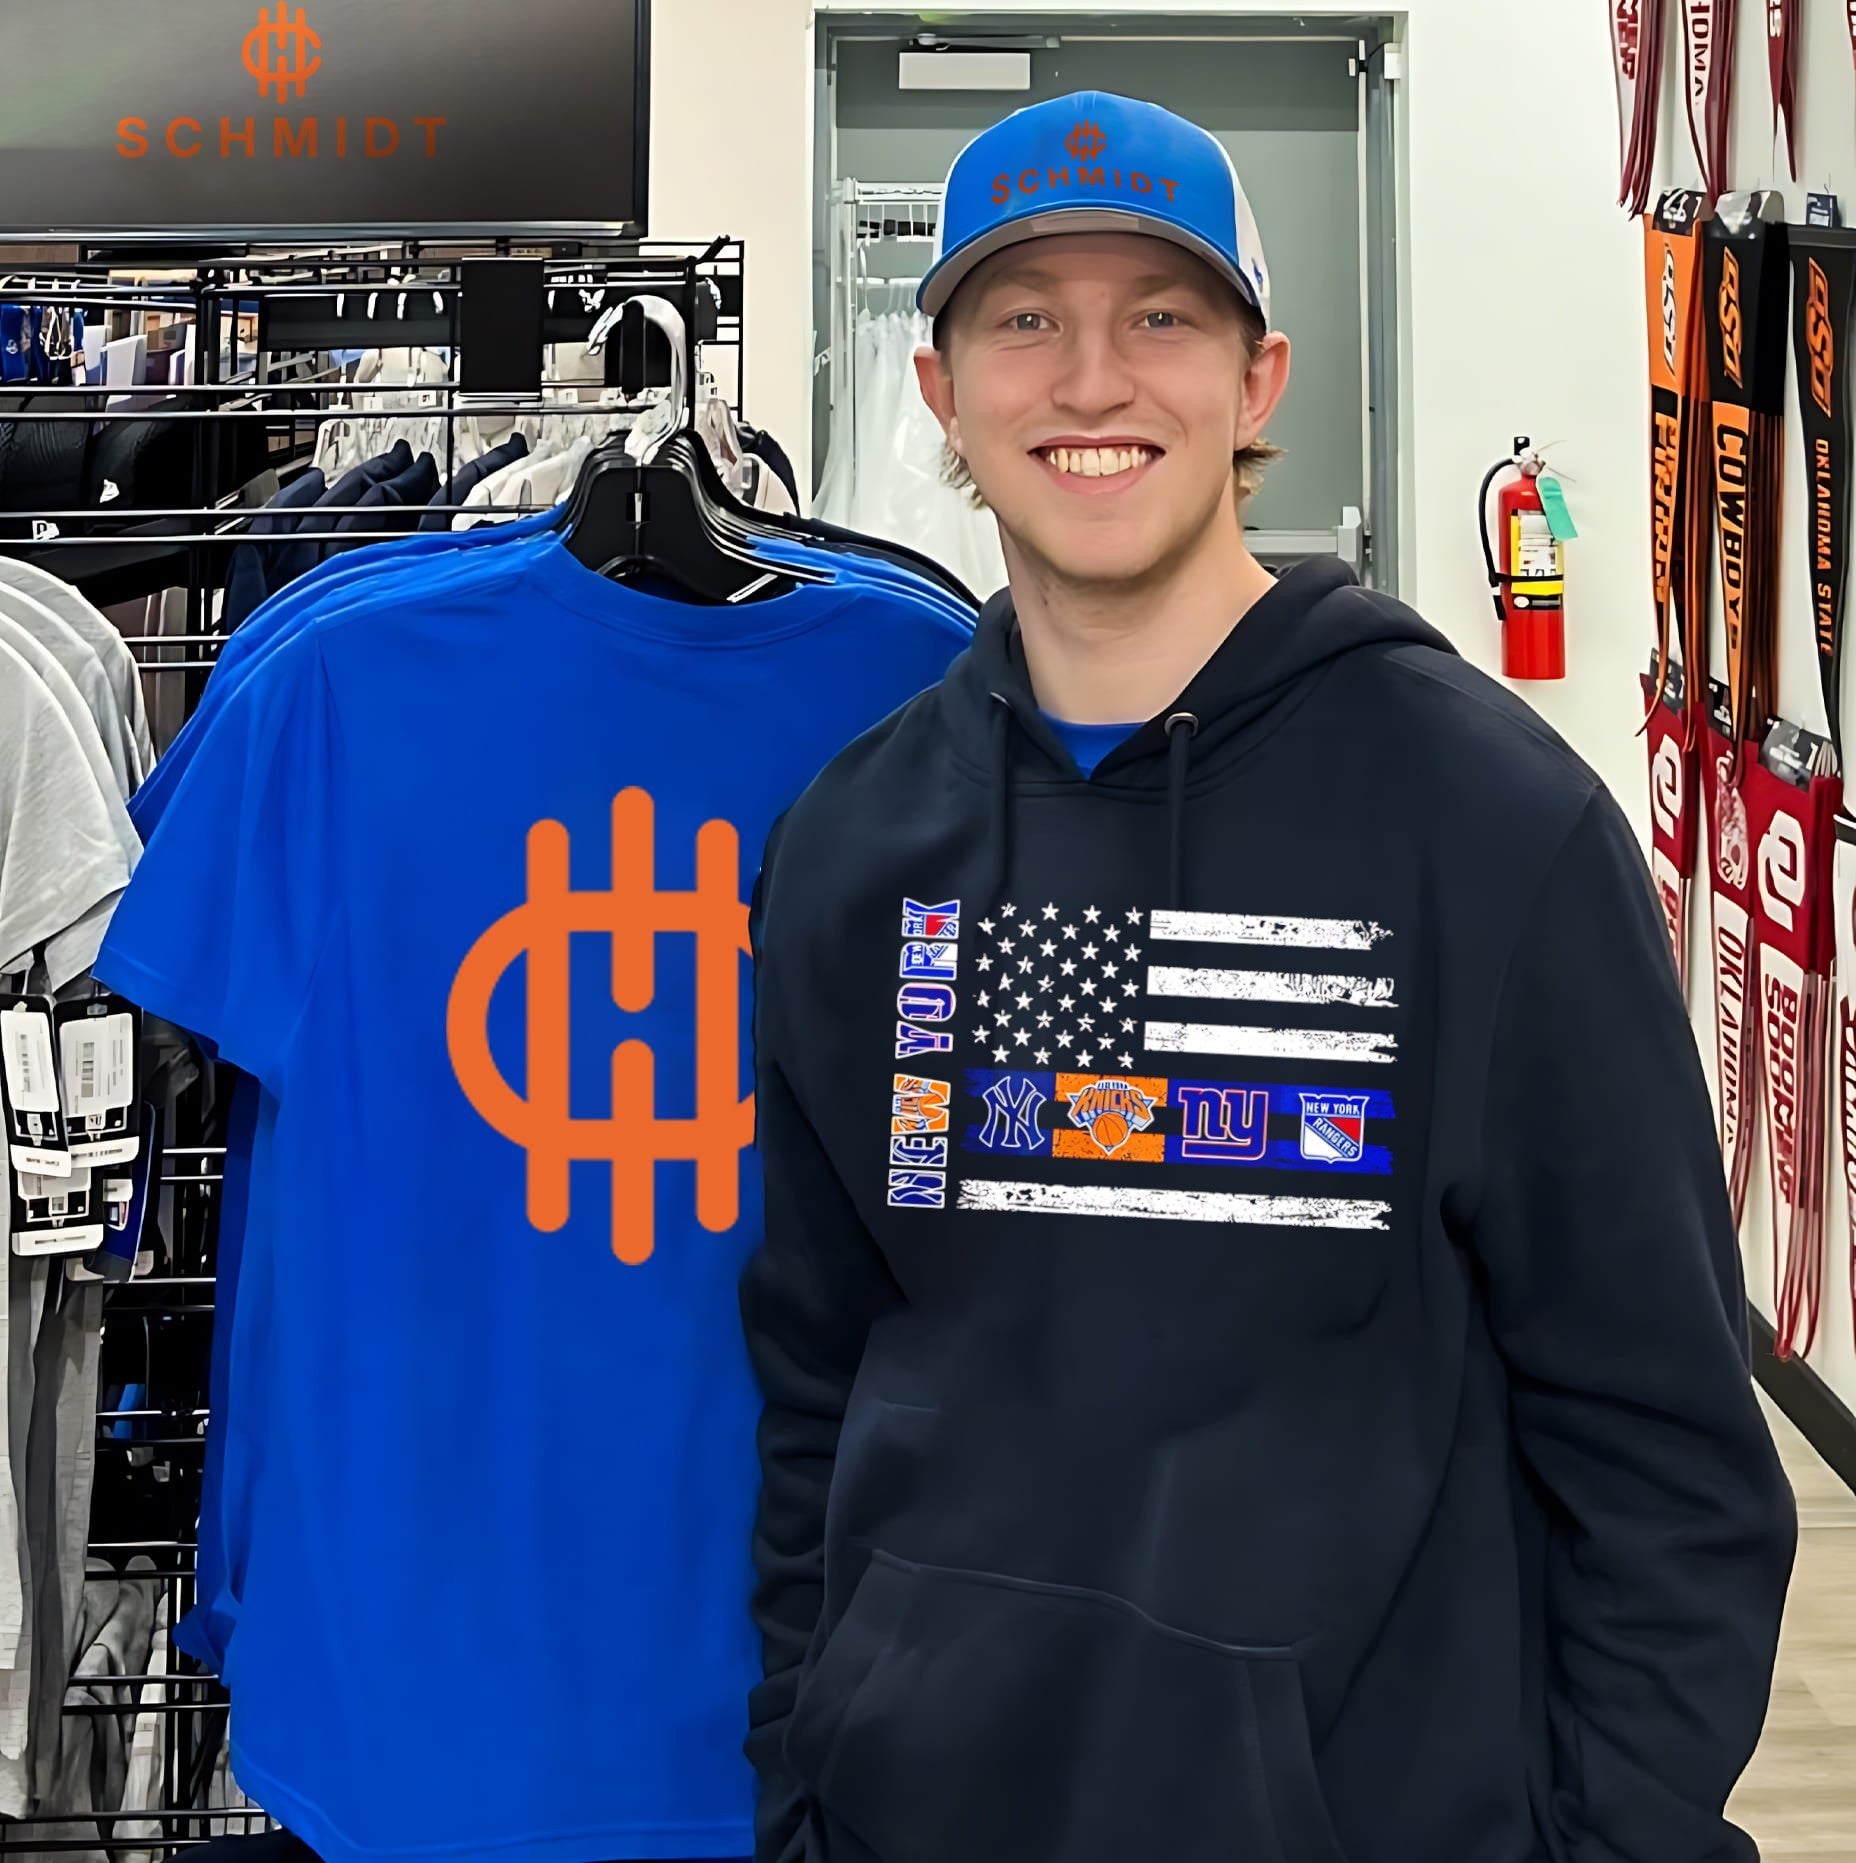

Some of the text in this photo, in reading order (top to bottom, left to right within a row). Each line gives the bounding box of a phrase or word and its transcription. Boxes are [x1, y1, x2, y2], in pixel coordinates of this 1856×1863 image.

[115, 116, 448, 159] SCHMIDT
[991, 165, 1180, 204] SCHMIDT
[1815, 438, 1832, 570] OKLAHOMA
[887, 897, 961, 1209] NEW YORK
[1071, 1086, 1152, 1121] KNICKS
[1306, 1102, 1360, 1115] NEW YORK
[1312, 1117, 1358, 1157] RANGERS
